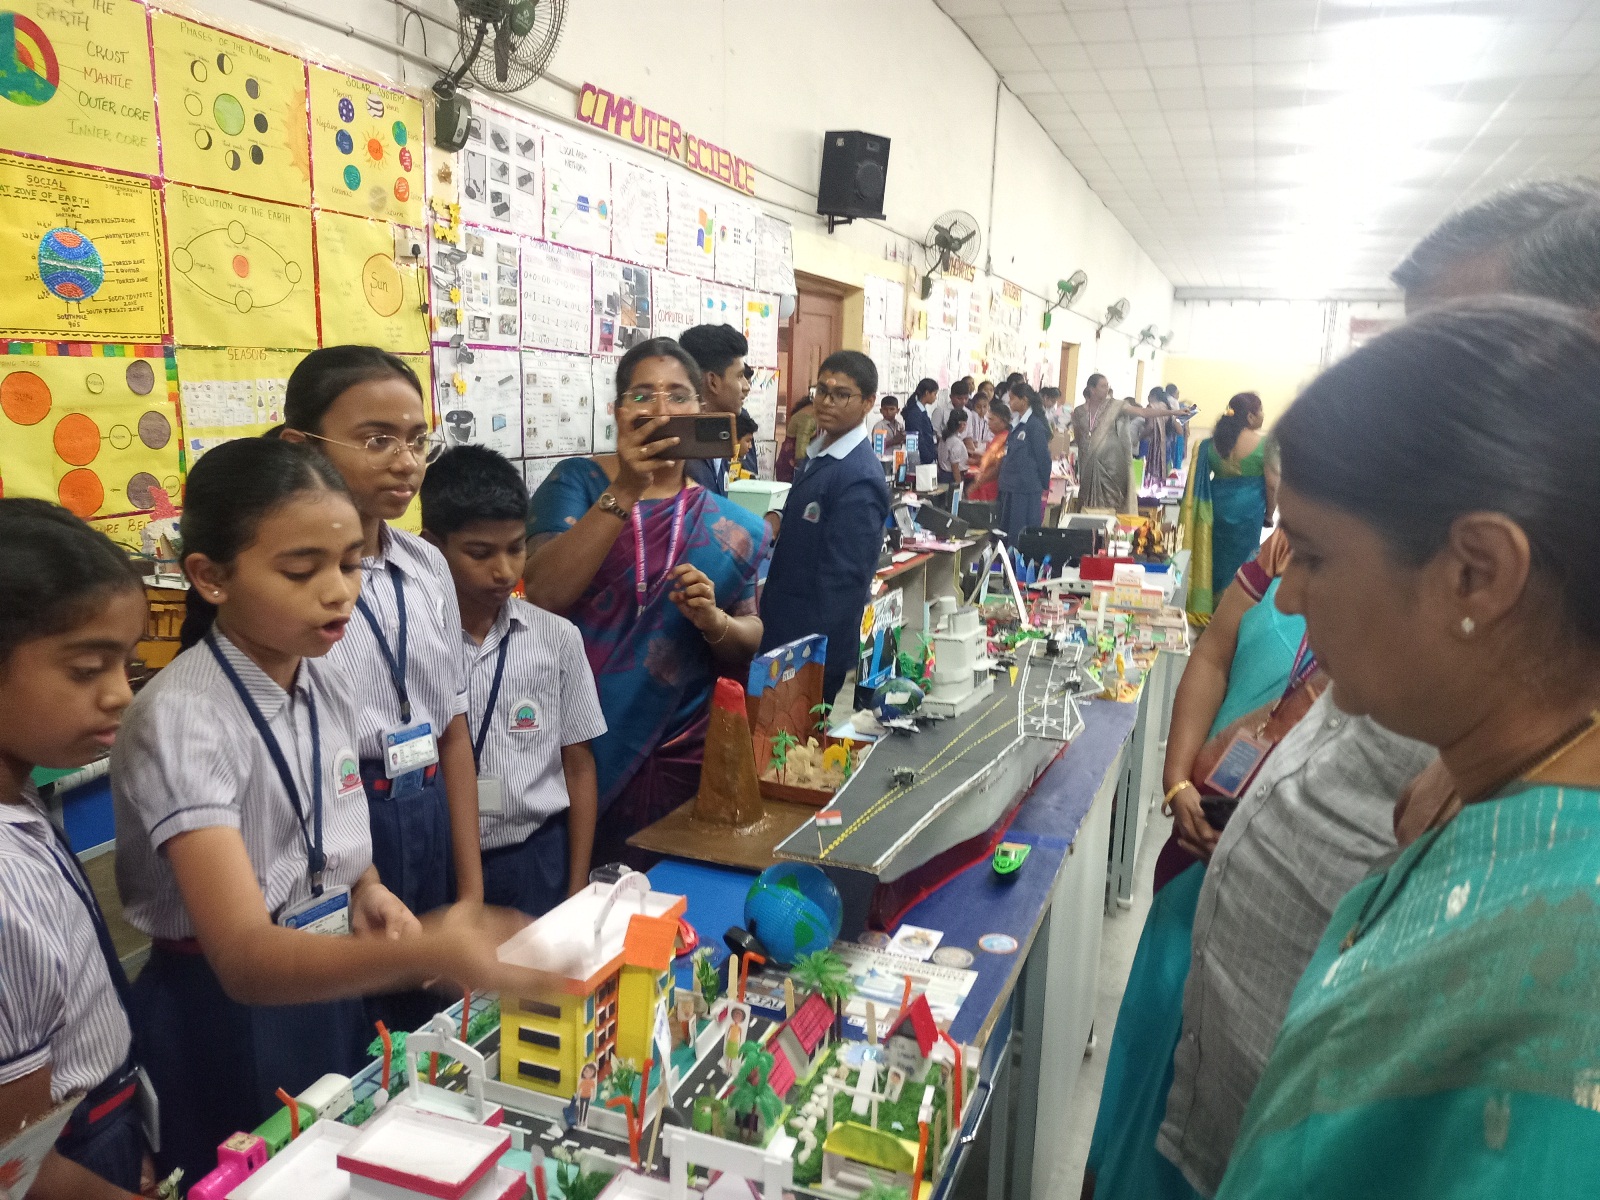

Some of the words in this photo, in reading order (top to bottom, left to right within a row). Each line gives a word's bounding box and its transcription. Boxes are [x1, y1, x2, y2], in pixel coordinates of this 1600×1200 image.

[36, 2, 89, 31] EARTH
[180, 22, 212, 42] PHASES
[219, 38, 228, 46] OF
[232, 42, 245, 53] THE
[87, 41, 129, 63] CRUST
[83, 67, 132, 89] MANTLE
[346, 77, 372, 94] SOLAR
[377, 88, 405, 104] SYSTEM
[79, 91, 116, 114] OUTER
[121, 105, 150, 121] CORE
[67, 118, 111, 142] INNER
[116, 132, 148, 147] CORE
[316, 118, 338, 132] Neptune
[577, 82, 682, 159] COMPUTER
[687, 134, 755, 196] SCIENCE
[14, 186, 37, 197] ZONE
[41, 191, 52, 199] OF
[58, 194, 90, 205] EARTH
[26, 175, 65, 190] SOCIAL
[181, 190, 233, 208] REVOLUTION
[238, 204, 248, 213] OF
[251, 207, 263, 218] THE
[268, 210, 291, 224] EARTH
[370, 271, 388, 297] Sun
[227, 348, 267, 361] SEASONS
